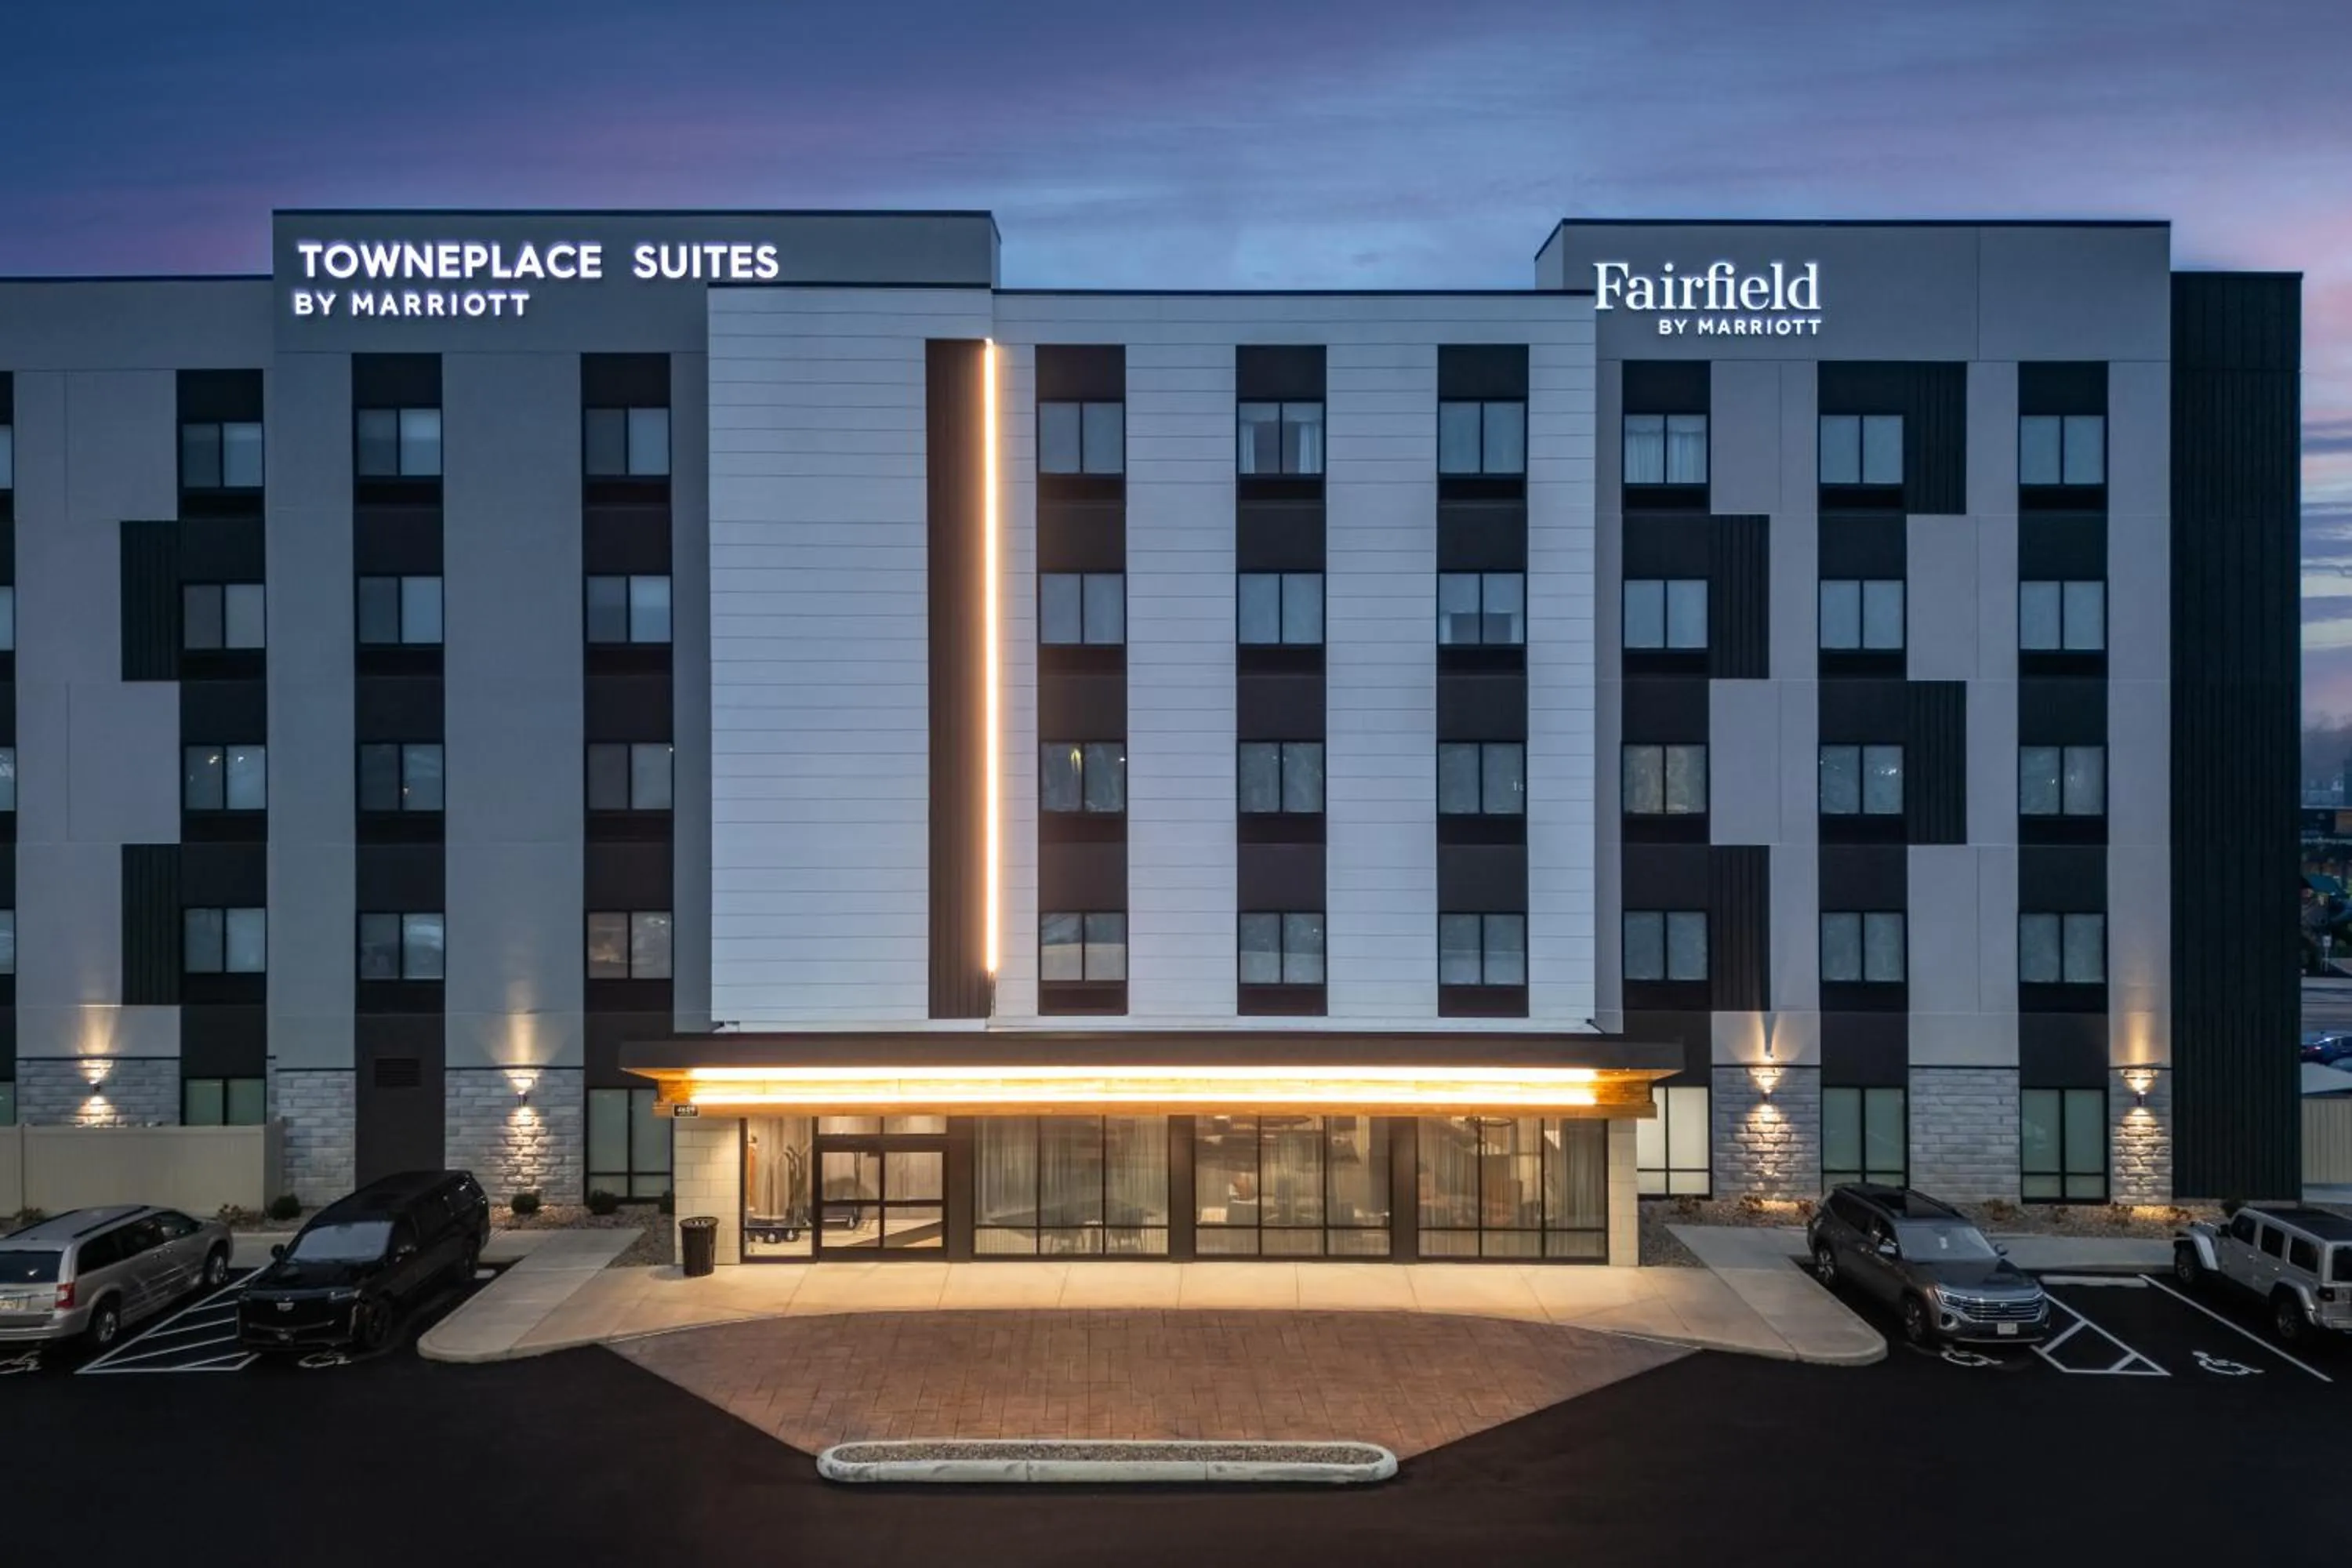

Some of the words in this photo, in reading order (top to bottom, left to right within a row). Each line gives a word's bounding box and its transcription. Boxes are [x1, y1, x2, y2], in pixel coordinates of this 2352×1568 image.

[298, 244, 602, 279] TOWNEPLACE
[633, 245, 779, 279] SUITES
[1593, 262, 1821, 310] Fairfield
[294, 292, 336, 315] BY
[352, 292, 530, 316] MARRIOTT
[1659, 319, 1687, 335] BY
[1698, 318, 1821, 335] MARRIOTT
